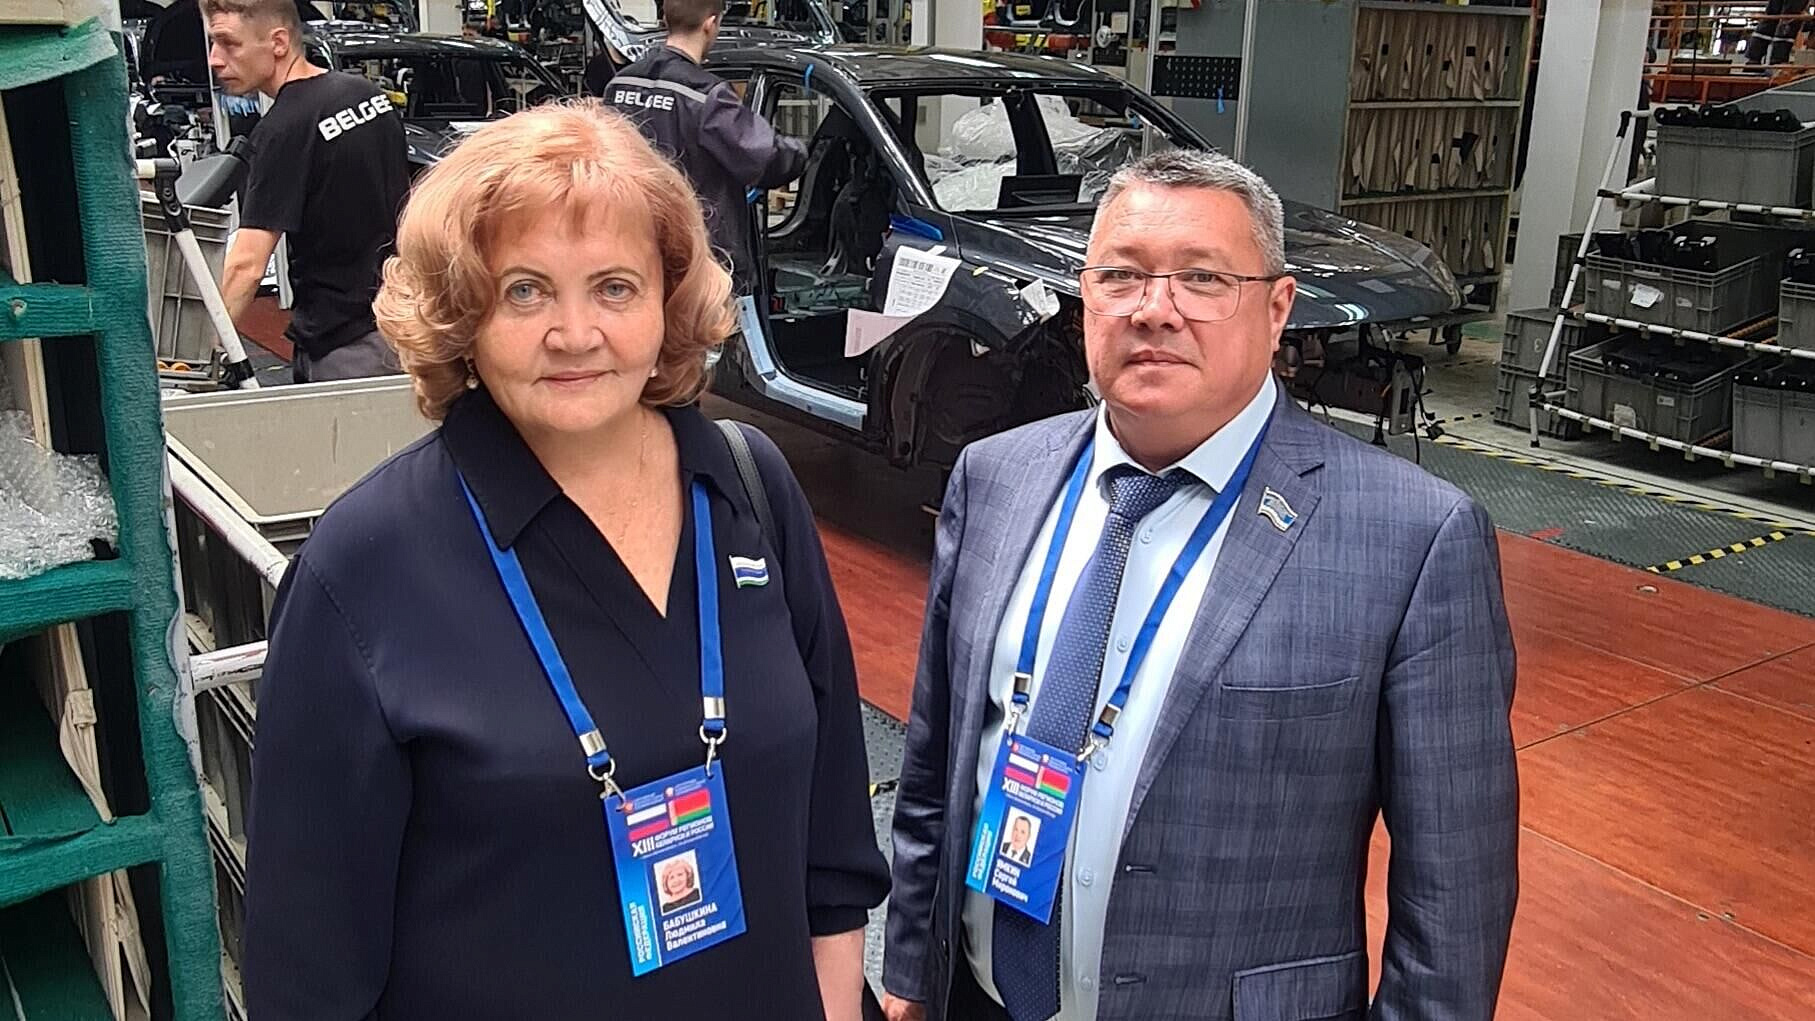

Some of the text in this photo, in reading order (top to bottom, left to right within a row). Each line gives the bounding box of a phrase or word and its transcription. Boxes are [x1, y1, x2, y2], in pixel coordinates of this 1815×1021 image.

[318, 94, 394, 142] BELGEE
[632, 837, 655, 857] XIII
[663, 902, 717, 931] БАБУШКИНА
